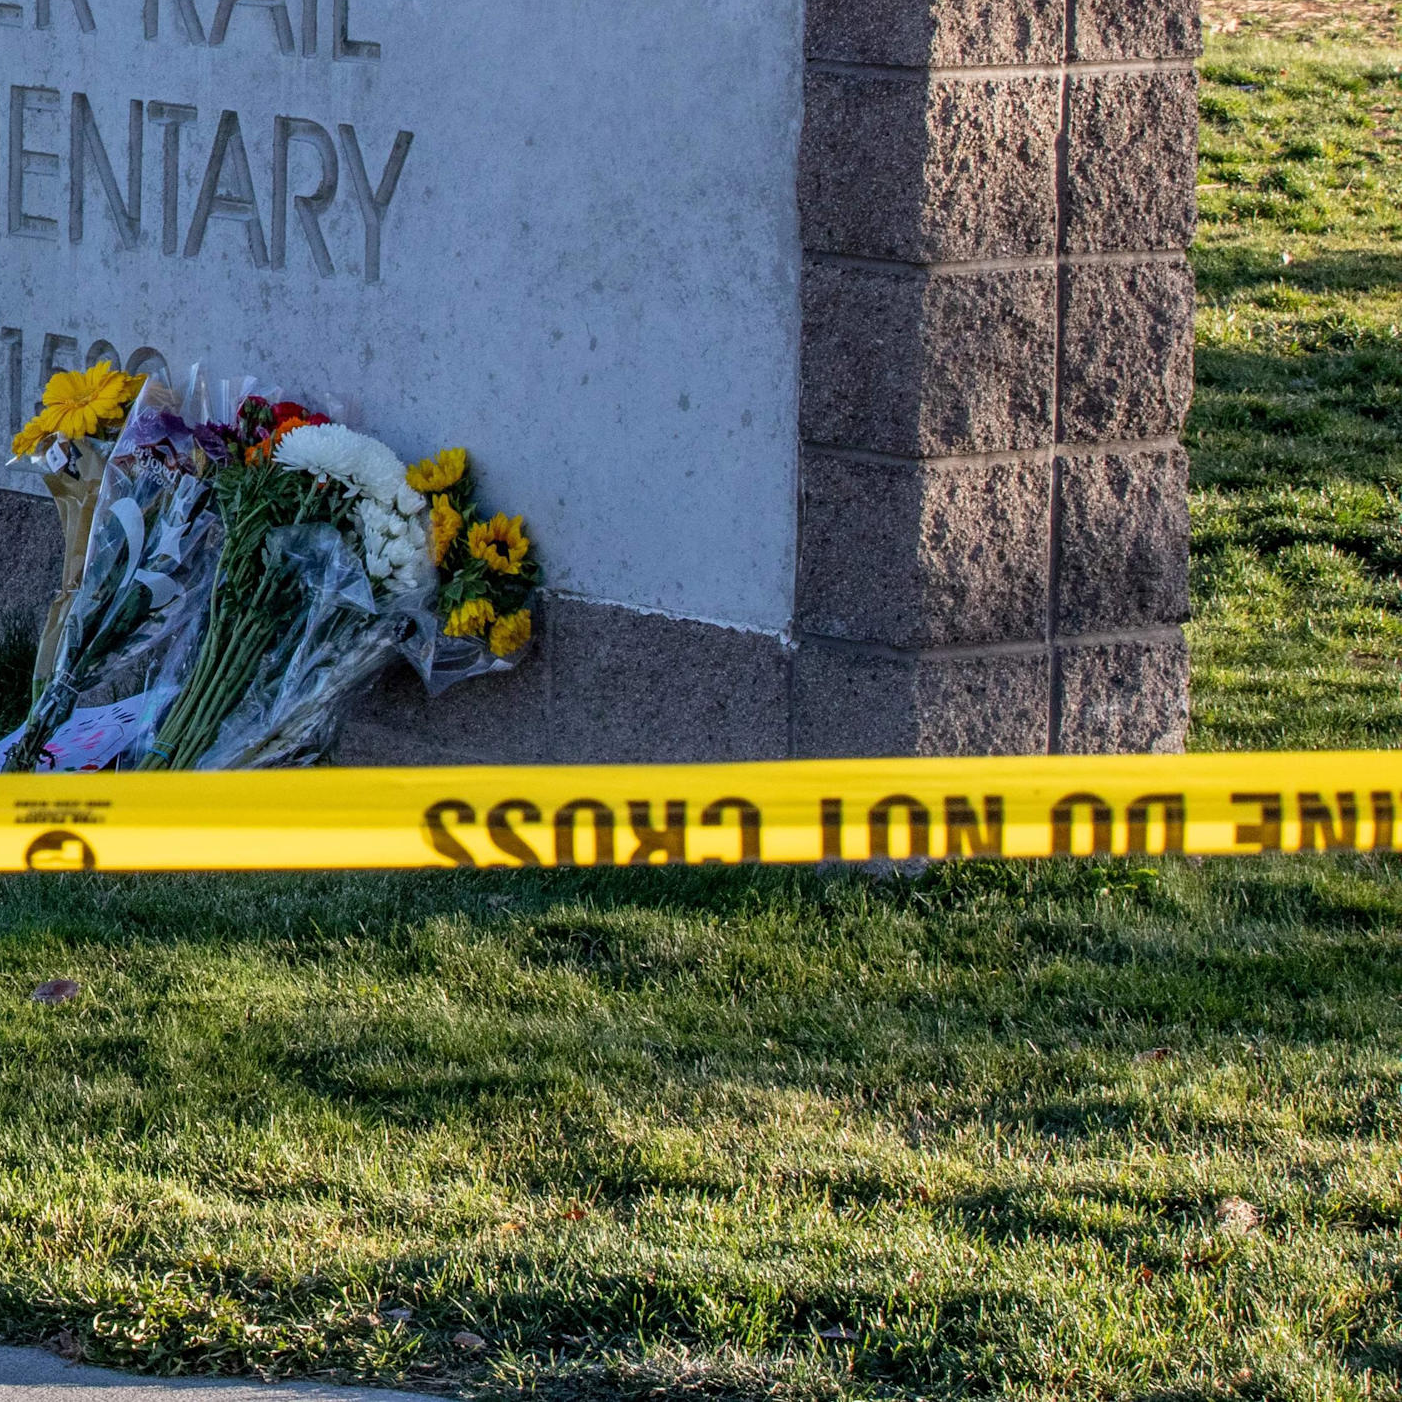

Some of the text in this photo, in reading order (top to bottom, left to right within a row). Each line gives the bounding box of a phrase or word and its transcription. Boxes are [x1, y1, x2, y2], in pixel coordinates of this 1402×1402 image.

[422, 791, 1402, 868] INE DO NOT CROSS
